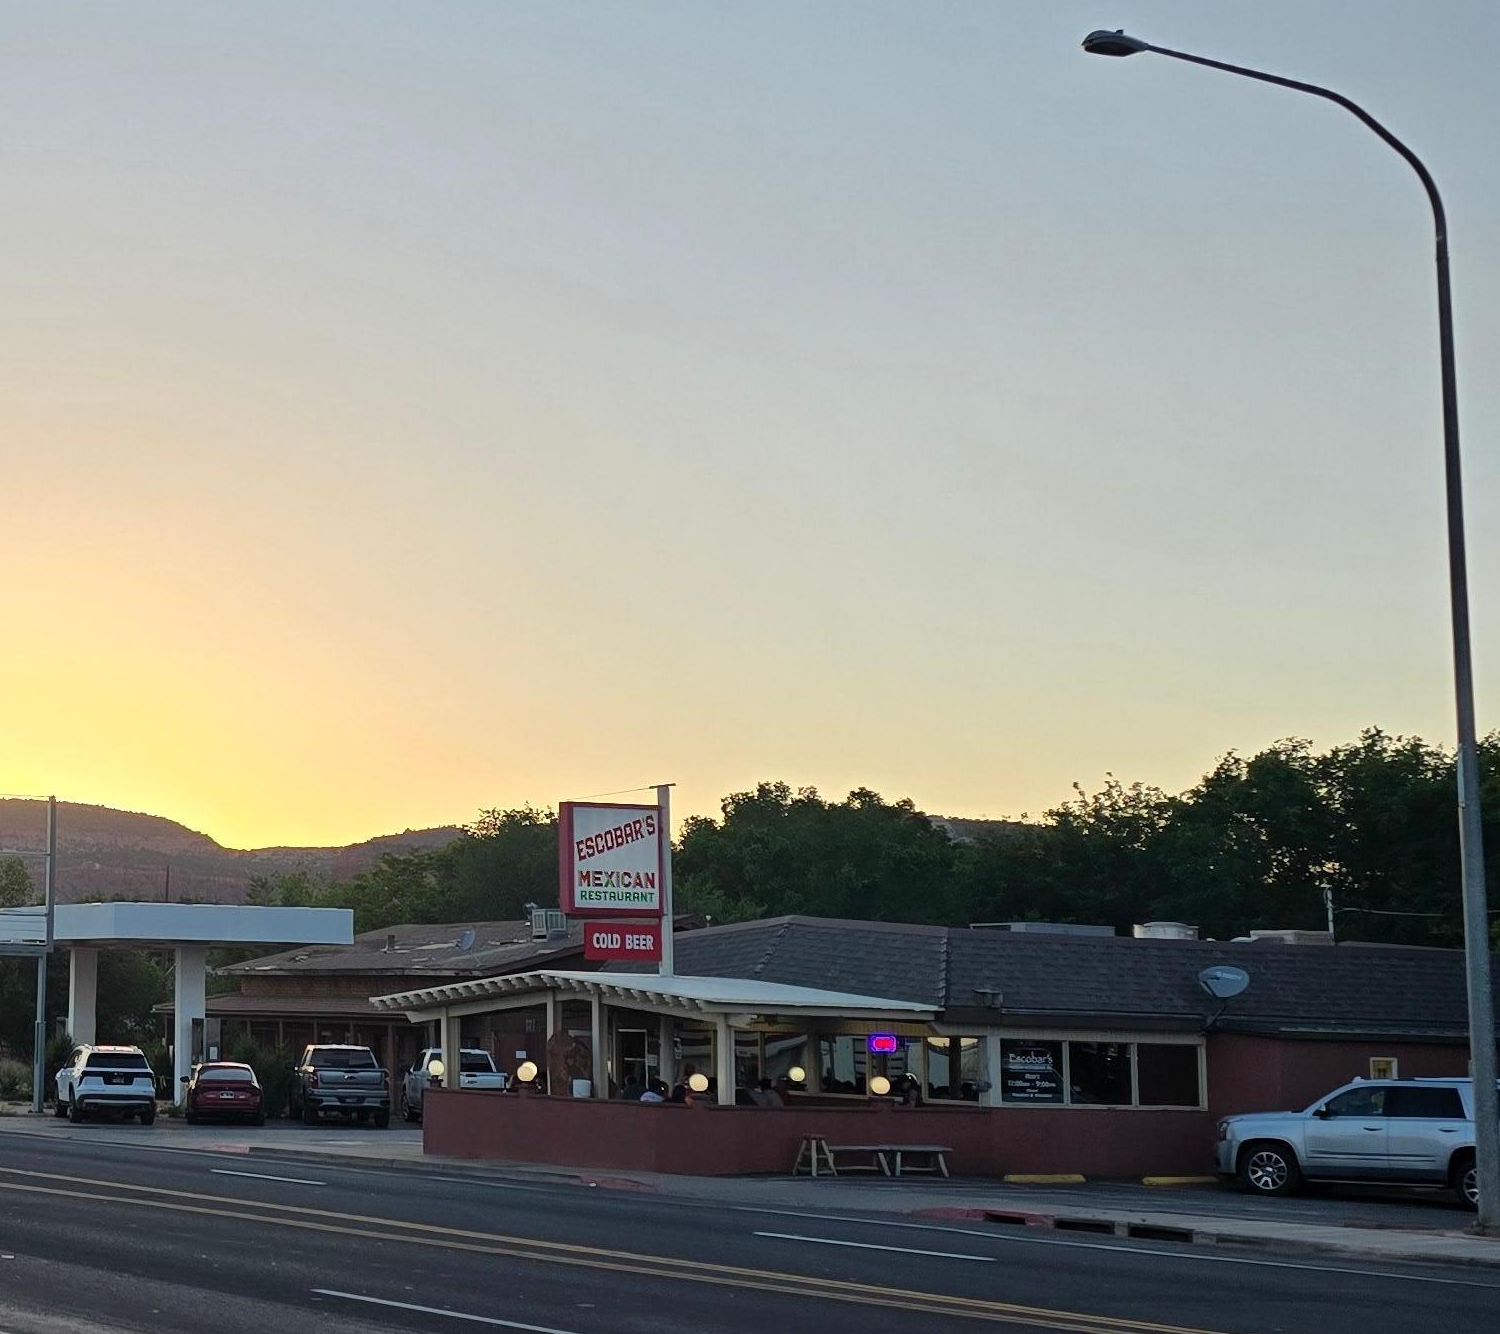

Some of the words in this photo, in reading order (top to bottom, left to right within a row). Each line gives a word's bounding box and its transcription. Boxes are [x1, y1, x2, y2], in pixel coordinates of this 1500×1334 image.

[575, 814, 656, 862] ESCOBAR'S
[578, 870, 656, 889] MEXICAN
[580, 890, 655, 903] RESTAURANT
[592, 933, 621, 949] COLD
[625, 934, 654, 950] BEER
